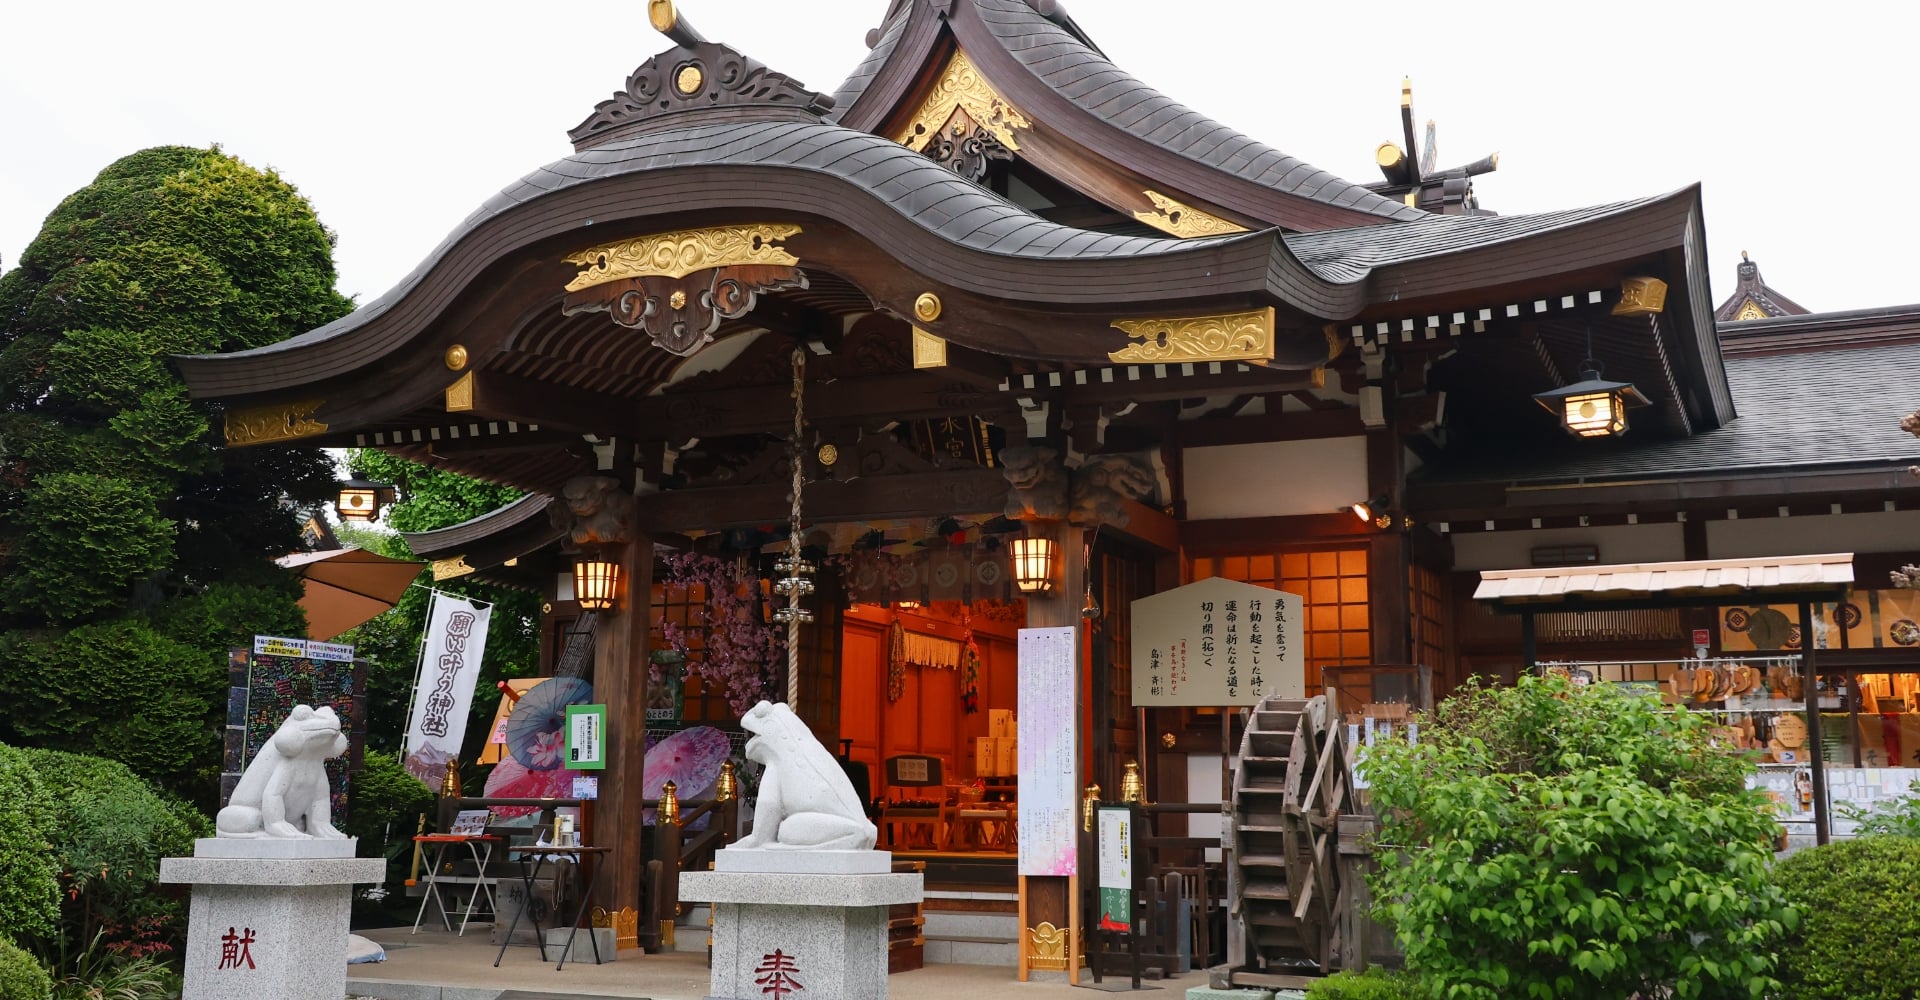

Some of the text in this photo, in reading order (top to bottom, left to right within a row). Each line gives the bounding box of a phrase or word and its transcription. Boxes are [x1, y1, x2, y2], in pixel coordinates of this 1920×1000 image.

[1225, 600, 1238, 697] 運命は新たなる道を
[1249, 599, 1264, 697] 行動を起こした時に
[1274, 598, 1287, 662] 勇気を奮って
[421, 611, 476, 738] 願い叶う神社
[218, 926, 256, 970] 献
[754, 948, 804, 1000] 奉
